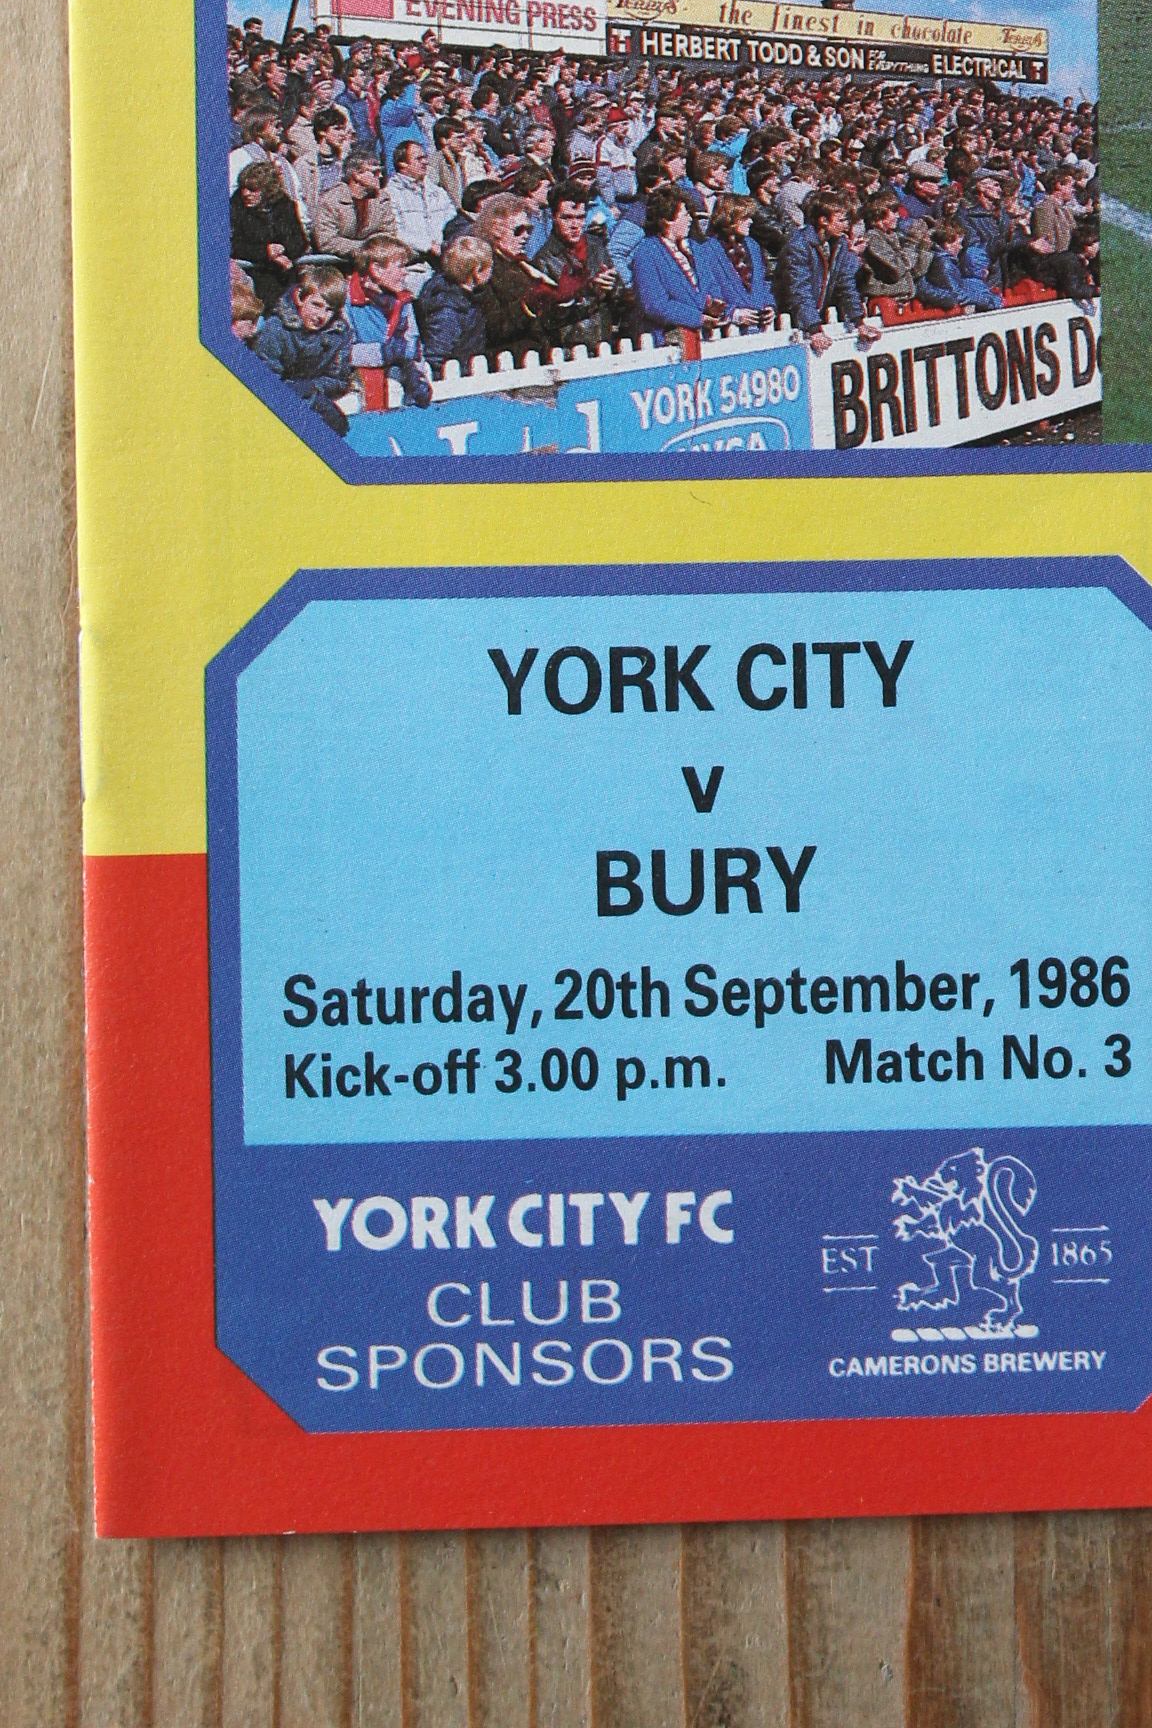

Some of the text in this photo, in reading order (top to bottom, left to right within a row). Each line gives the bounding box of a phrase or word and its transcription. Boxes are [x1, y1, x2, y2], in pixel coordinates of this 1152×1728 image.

[528, 1, 598, 32] PRESS
[771, 3, 840, 34] finest
[857, 15, 874, 36] in
[891, 16, 973, 44] chocolate
[640, 30, 741, 61] HERBERT
[746, 39, 803, 65] TODD
[806, 44, 822, 67] &
[824, 46, 865, 70] SON
[932, 54, 1027, 79] ELECTRICAL
[630, 377, 715, 430] YORK
[719, 364, 801, 414] 54980
[831, 316, 1101, 449] BRITTONS D
[488, 640, 914, 715] YORK CITY
[681, 766, 724, 814] v
[595, 845, 818, 917] BURY
[284, 956, 1130, 1036] Saturday, 20th September, 1986
[284, 1050, 728, 1101] Kick-off 3.00 p.m.
[824, 1035, 1133, 1086] Match No. 3
[313, 1190, 735, 1252] YORK CITY FC
[822, 1240, 1113, 1274] EST 1865
[426, 1280, 622, 1328] CLUB
[316, 1337, 734, 1391] SPONSORS
[829, 1349, 1107, 1377] CAMERONS BREWERY
